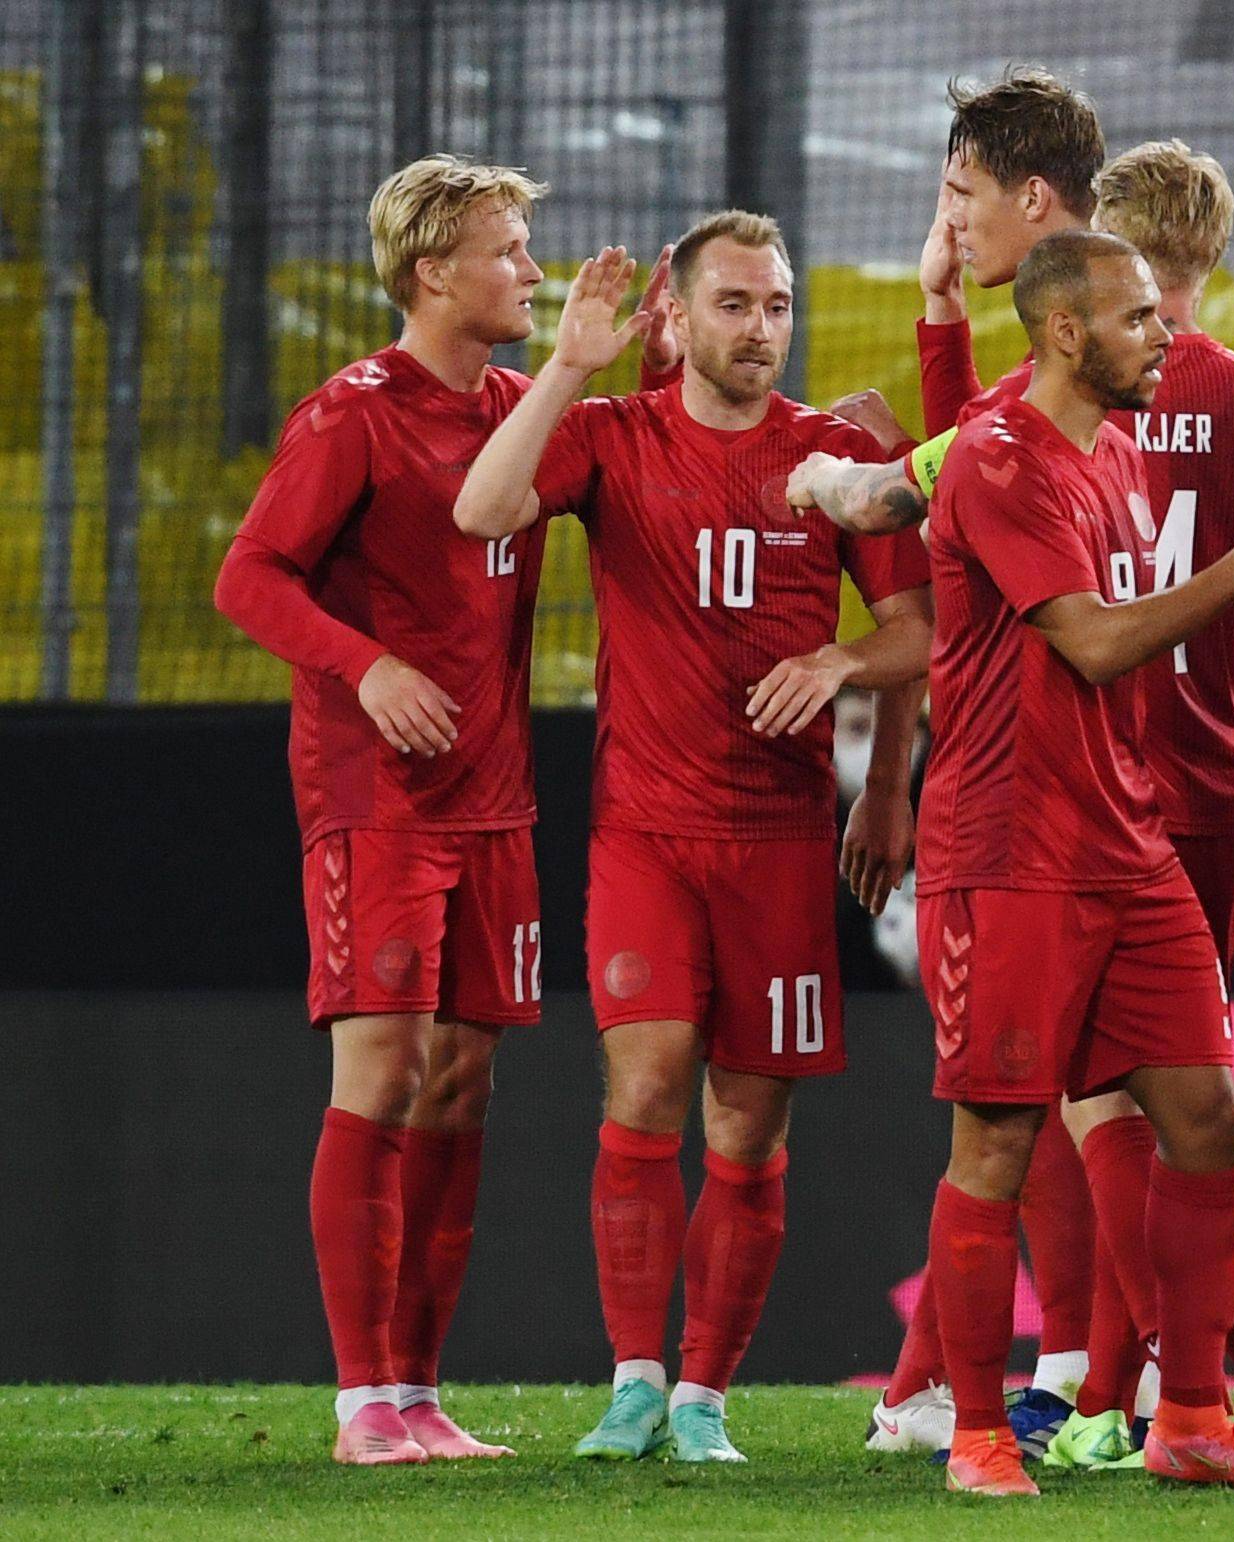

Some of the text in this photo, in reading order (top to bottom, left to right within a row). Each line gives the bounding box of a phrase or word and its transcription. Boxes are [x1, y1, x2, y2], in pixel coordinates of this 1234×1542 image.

[1134, 412, 1212, 453] KJÆR
[694, 528, 756, 609] 10
[1109, 551, 1137, 600] 9
[512, 920, 541, 1003] 12
[767, 974, 824, 1054] 10
